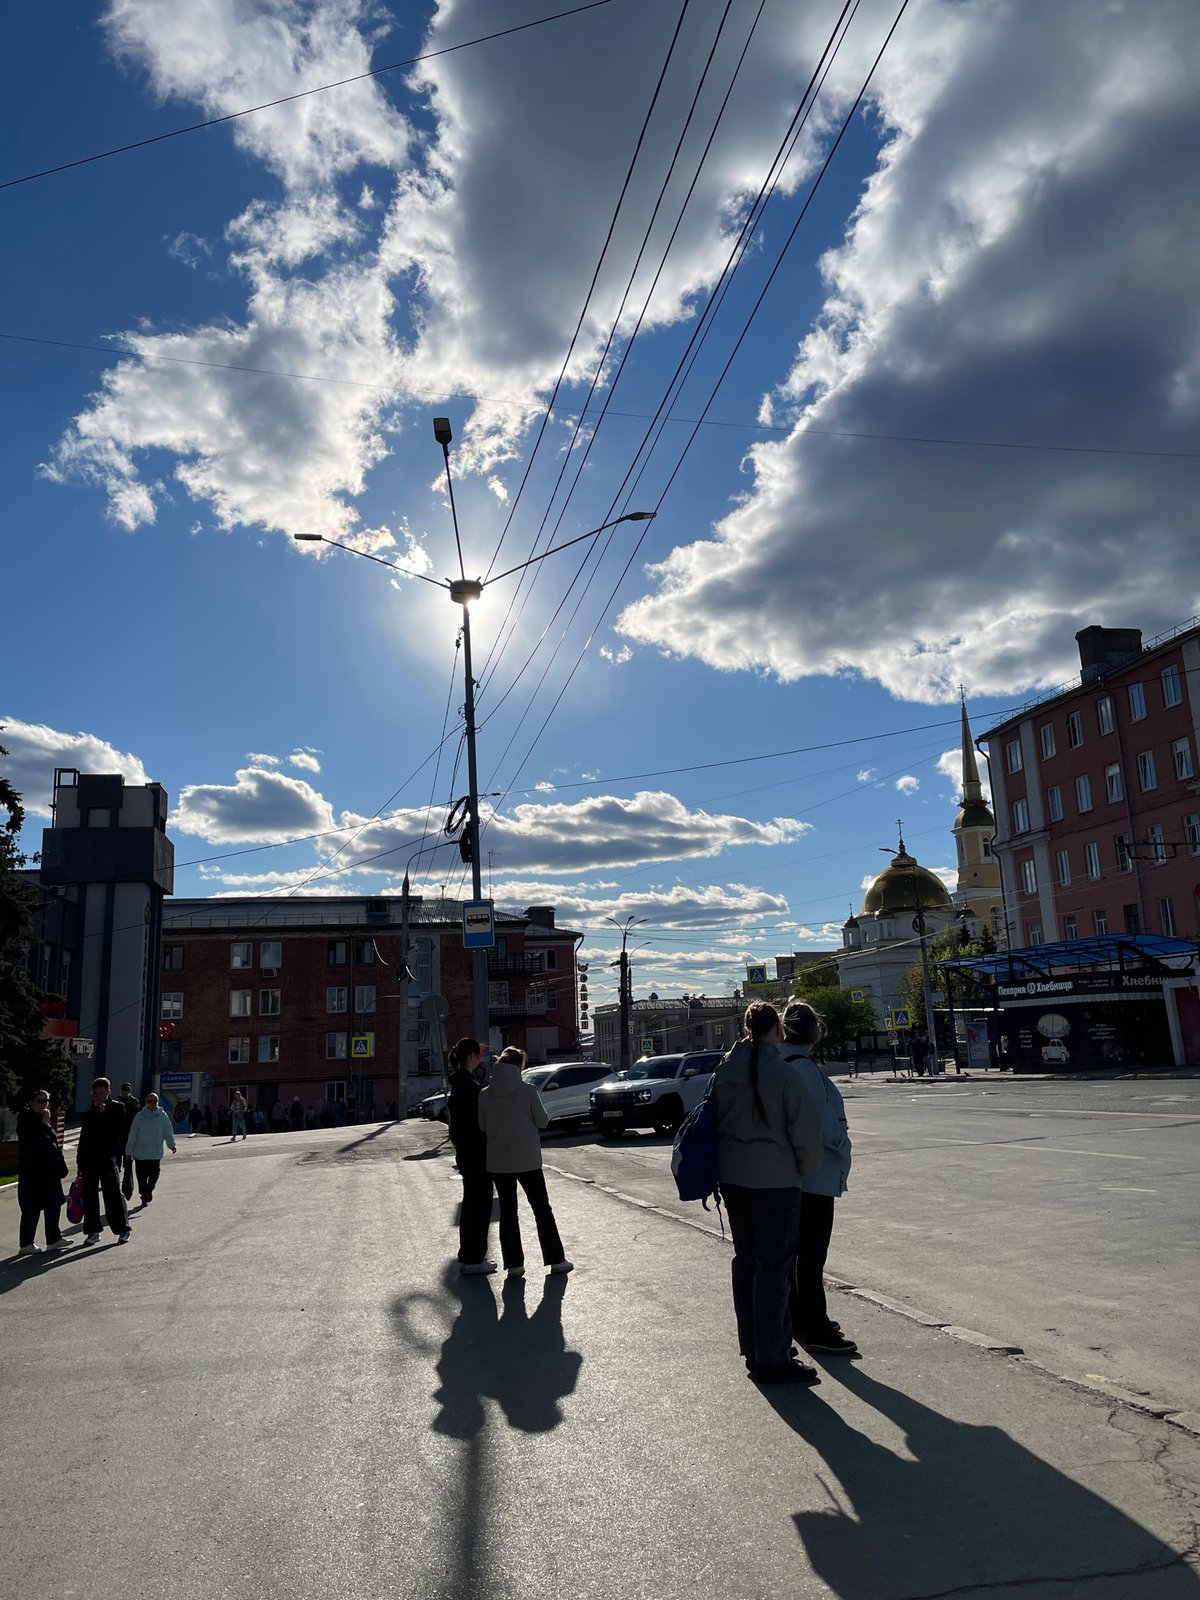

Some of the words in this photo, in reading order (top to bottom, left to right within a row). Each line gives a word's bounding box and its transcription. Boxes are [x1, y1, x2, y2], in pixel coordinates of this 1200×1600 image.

[1122, 975, 1171, 986] Хлебни
[997, 985, 1026, 997] Пекарня
[1036, 981, 1074, 992] Хлебница
